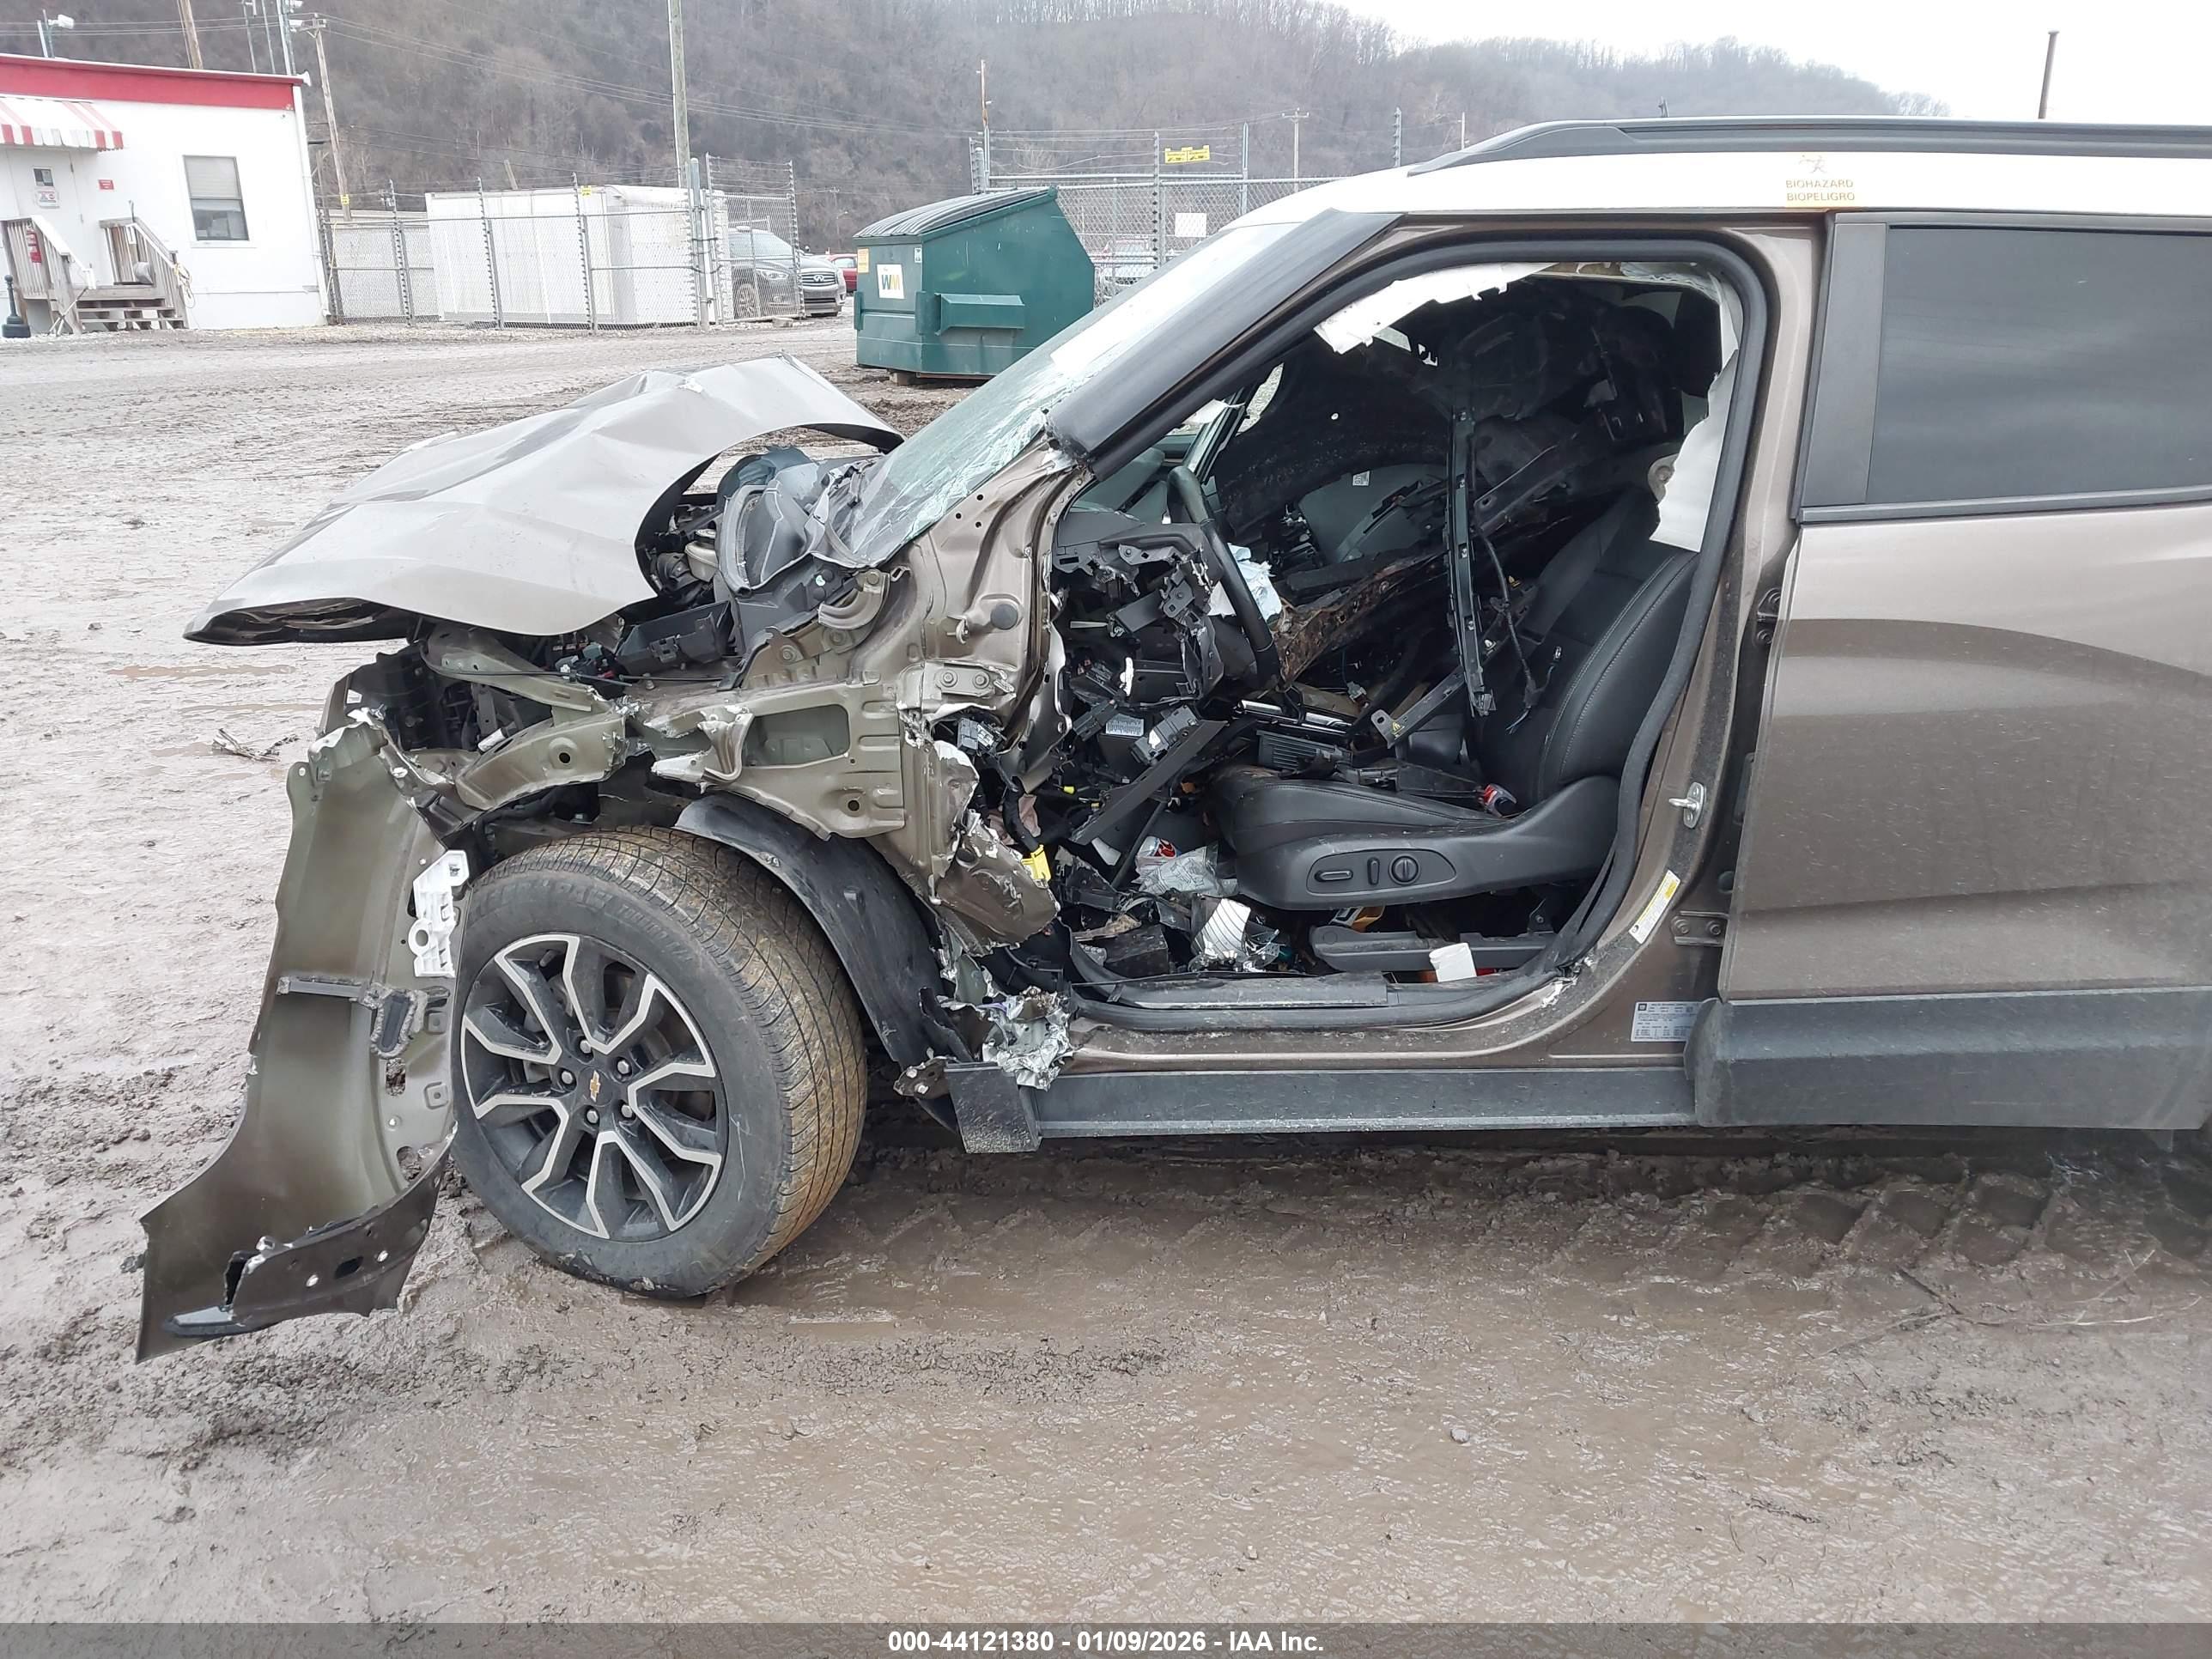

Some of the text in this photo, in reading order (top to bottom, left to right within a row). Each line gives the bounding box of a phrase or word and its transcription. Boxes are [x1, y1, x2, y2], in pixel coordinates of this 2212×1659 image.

[1785, 179, 1854, 188] BIOHAZARD
[1787, 191, 1856, 201] BIOPELIGRO
[881, 274, 901, 290] WM
